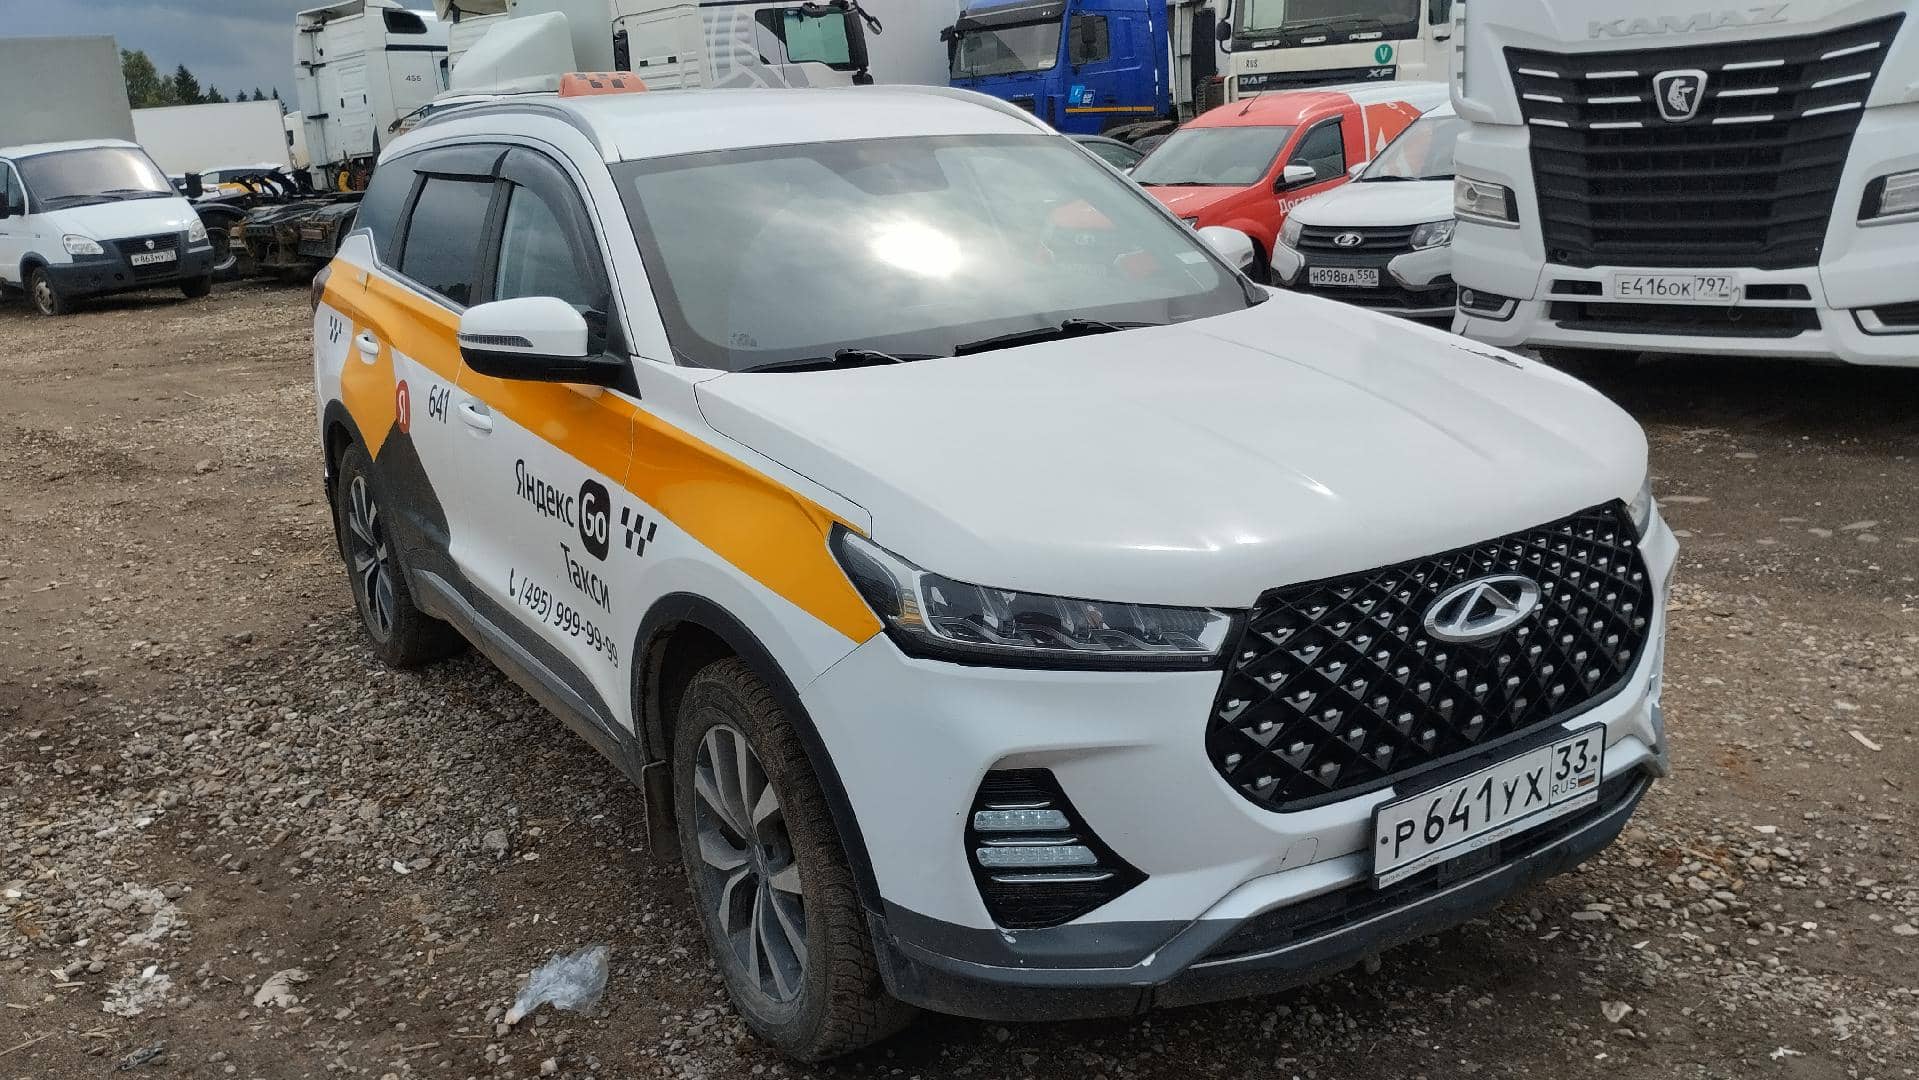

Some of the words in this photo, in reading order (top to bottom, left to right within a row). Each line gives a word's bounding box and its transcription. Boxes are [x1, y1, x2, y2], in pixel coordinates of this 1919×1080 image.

[1587, 2, 1791, 39] KAMAZ
[1239, 75, 1268, 86] DAF
[1366, 67, 1394, 79] XF
[1312, 269, 1355, 283] Н898ВА
[1357, 269, 1376, 280] 550
[1620, 277, 1691, 296] Е416ОК
[1697, 277, 1726, 292] 797
[428, 384, 451, 425] 641
[515, 458, 575, 528] Яндекс
[580, 491, 608, 545] Go
[559, 541, 611, 614] Такси
[518, 576, 553, 623] (495)
[553, 601, 620, 669] 999-99-99
[1394, 766, 1545, 859] Р641УХ
[1555, 738, 1590, 781] 33
[1551, 777, 1578, 798] RUS
